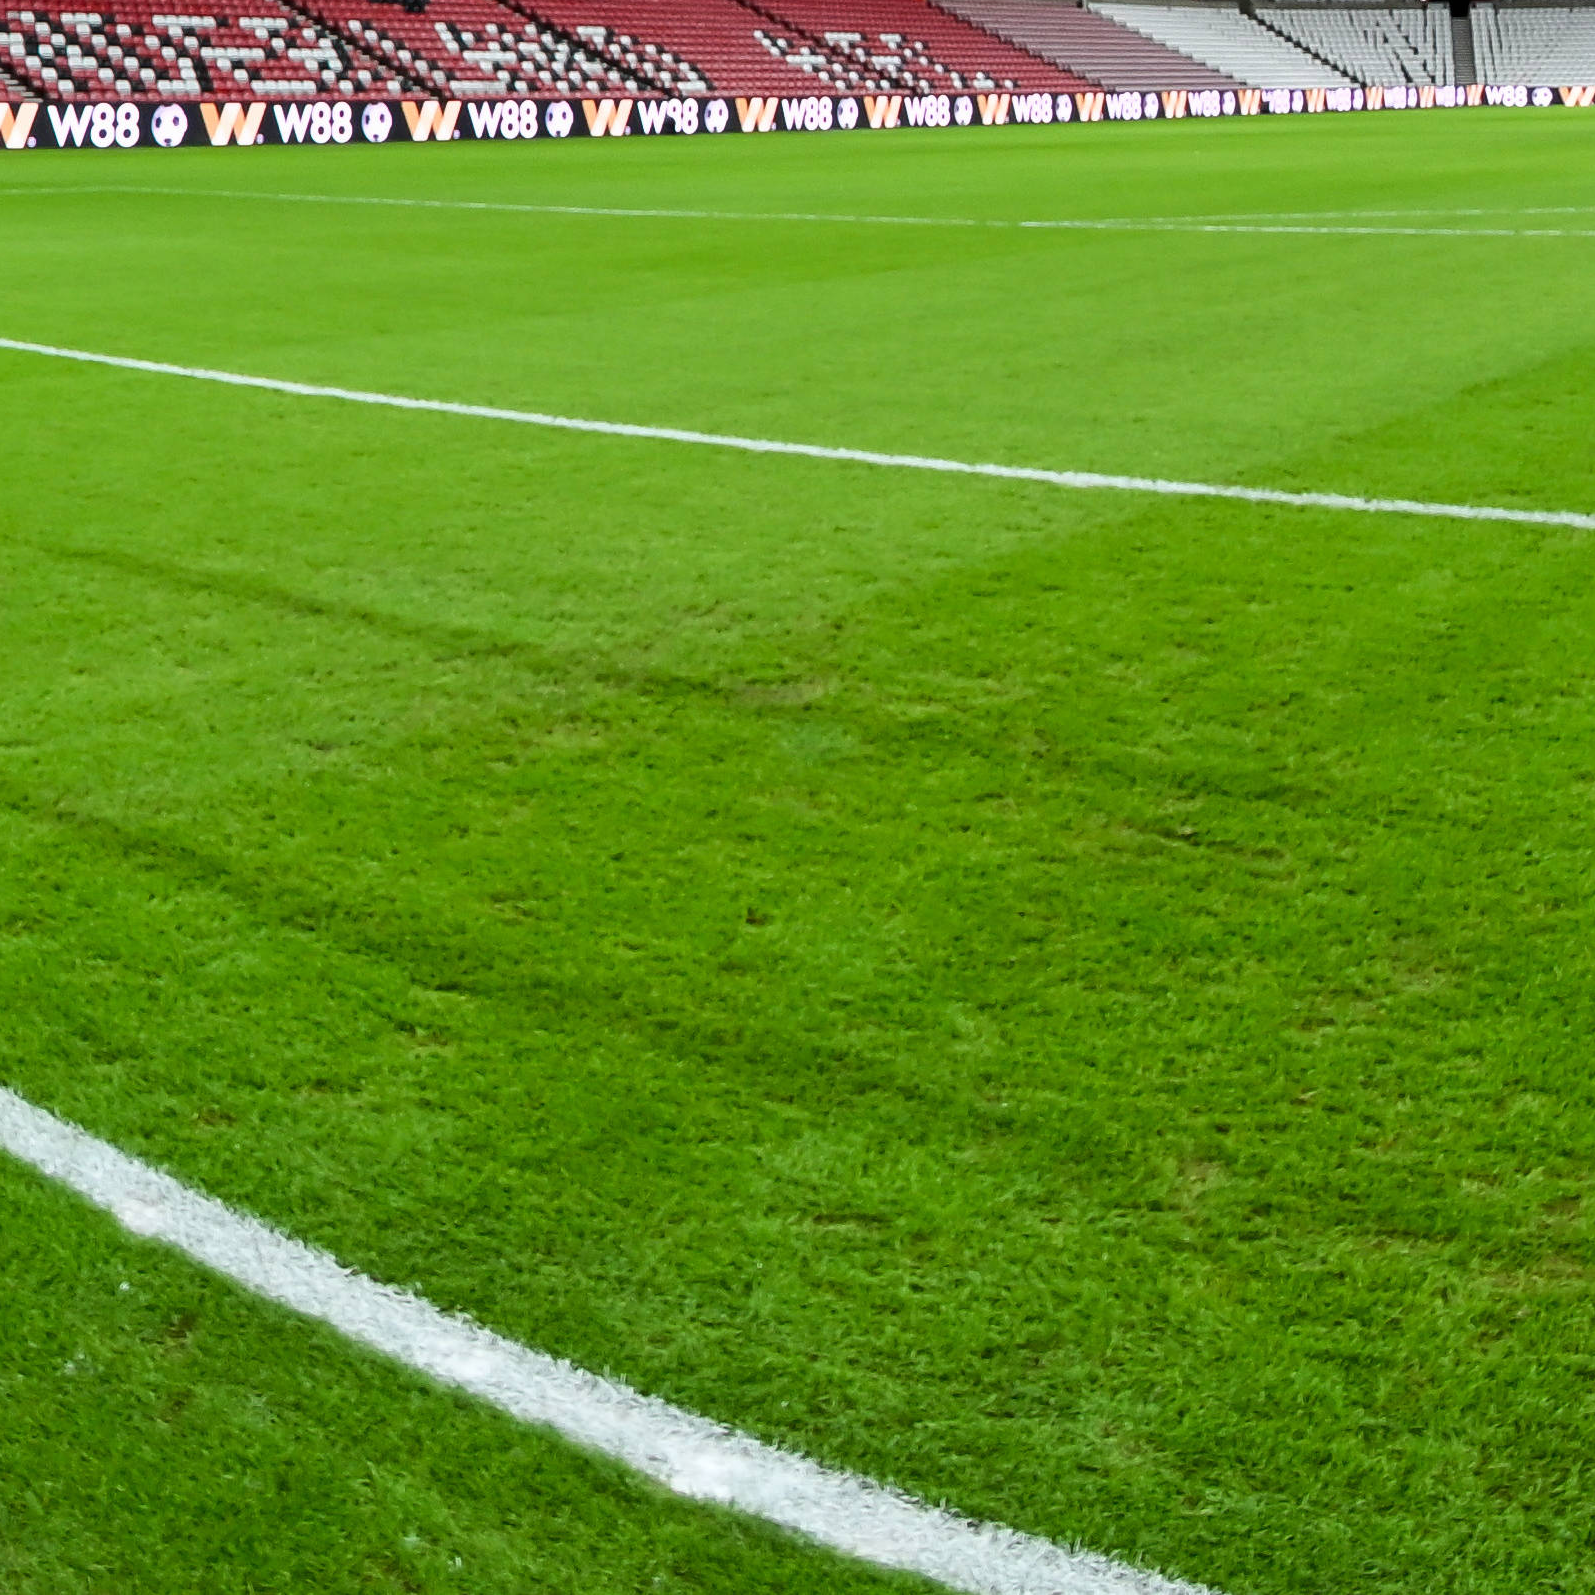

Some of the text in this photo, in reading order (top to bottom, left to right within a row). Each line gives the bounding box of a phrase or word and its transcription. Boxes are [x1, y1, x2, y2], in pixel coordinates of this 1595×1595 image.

[904, 95, 950, 127] W88
[1011, 93, 1052, 124] W88
[1105, 91, 1142, 121] W88
[1485, 86, 1527, 108] W88
[47, 103, 140, 148] W88
[273, 102, 353, 144] W88
[467, 100, 538, 140] W88
[781, 97, 833, 131] W88
